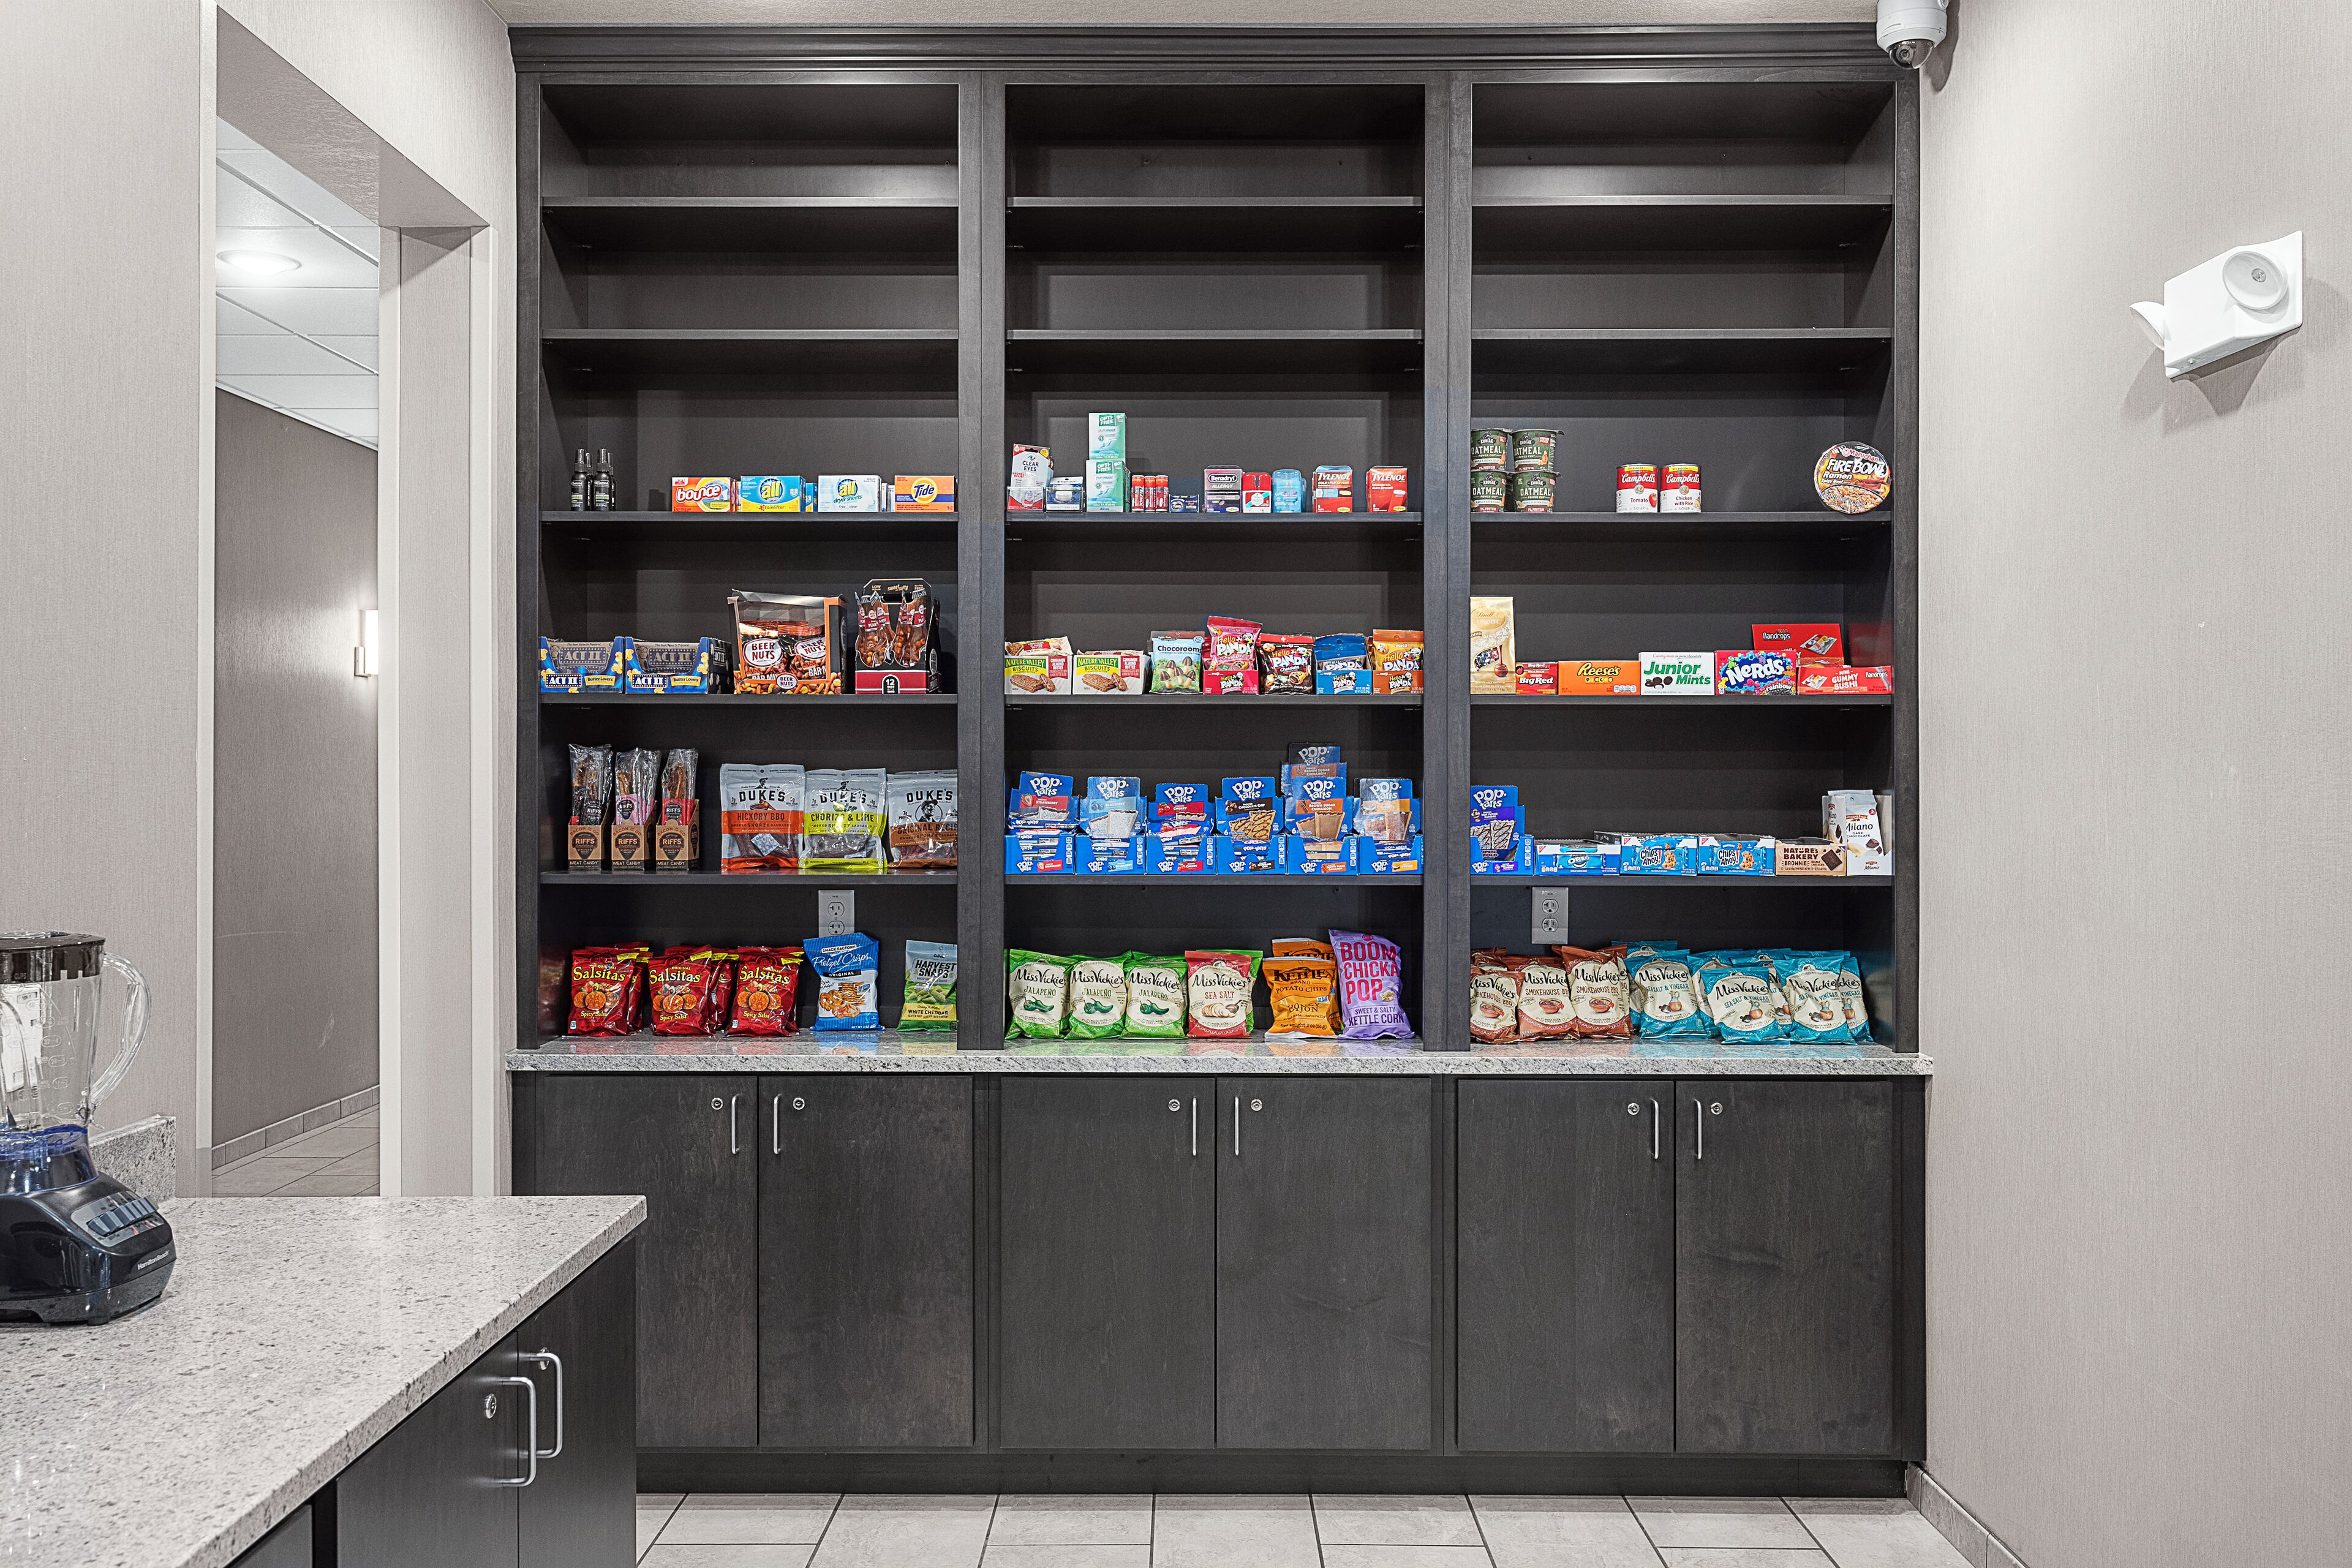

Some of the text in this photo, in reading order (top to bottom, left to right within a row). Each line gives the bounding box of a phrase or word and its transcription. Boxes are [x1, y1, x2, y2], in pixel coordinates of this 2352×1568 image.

[1471, 446, 1502, 455] OATMEAL
[1849, 449, 1879, 462] Maruchan
[1826, 458, 1852, 472] FIRE
[1371, 473, 1406, 482] TYLENOL
[1822, 471, 1853, 480] Ramen
[676, 486, 722, 502] bounce
[762, 481, 781, 499] all
[839, 480, 856, 497] all
[913, 485, 935, 499] Tide
[1520, 488, 1551, 496] OATMEAL
[1218, 635, 1236, 644] Hello
[1762, 631, 1791, 641] Raindrops
[752, 642, 775, 650] BEER
[1217, 643, 1253, 656] PANDA
[752, 650, 775, 661] NUTS
[1384, 654, 1403, 662] Hello
[1006, 658, 1045, 668] NATURE VALLEY
[1077, 658, 1118, 667] NATURE VALLEY
[1272, 655, 1308, 668] PANDA
[1383, 660, 1420, 671] PANDA
[809, 667, 821, 677] BAR
[1578, 663, 1621, 676] Reese's
[1643, 662, 1702, 674] Junior
[549, 677, 578, 685] ACT II
[635, 677, 665, 685] ACT II
[1220, 679, 1243, 688] PANDA
[1333, 679, 1355, 688] PANDA
[1389, 679, 1411, 689] PANDA
[1676, 675, 1711, 685] Mints
[1831, 673, 1858, 684] GUMMY
[1765, 684, 1792, 692] rainbow
[1834, 680, 1858, 690] SUSHI
[739, 789, 786, 802] DUKE'S
[907, 788, 953, 803] DUKE'S
[1845, 823, 1874, 832] Milano
[1568, 855, 1590, 865] OREO
[1641, 849, 1659, 860] Chips
[1642, 850, 1662, 866] Ahoy!
[1718, 850, 1736, 861] Chips
[1721, 850, 1739, 867] Ahoy!
[1340, 941, 1396, 962] BOOM
[812, 952, 870, 971] Pretzel Crisps
[915, 960, 957, 971] HARVEST
[573, 966, 625, 982] Salsitas
[740, 966, 790, 984] Salsitas
[1273, 968, 1329, 982] KETTLE
[1344, 961, 1399, 979] CHICKA
[650, 968, 701, 984] Salsitas
[1071, 969, 1125, 988] Miss Vickie's
[1192, 973, 1247, 990] Miss Vickie's
[1129, 972, 1180, 993] Miss Vickie's
[1024, 986, 1056, 997] JALAPEÑO
[1082, 987, 1112, 997] JALAPEÑO
[1346, 979, 1383, 1004] POP
[1610, 986, 1619, 995] BBQ
[1819, 992, 1839, 1001] VINEGAR
[1349, 1014, 1404, 1027] KETTLE CORN
[138, 1250, 170, 1270] Hamilton Beach
